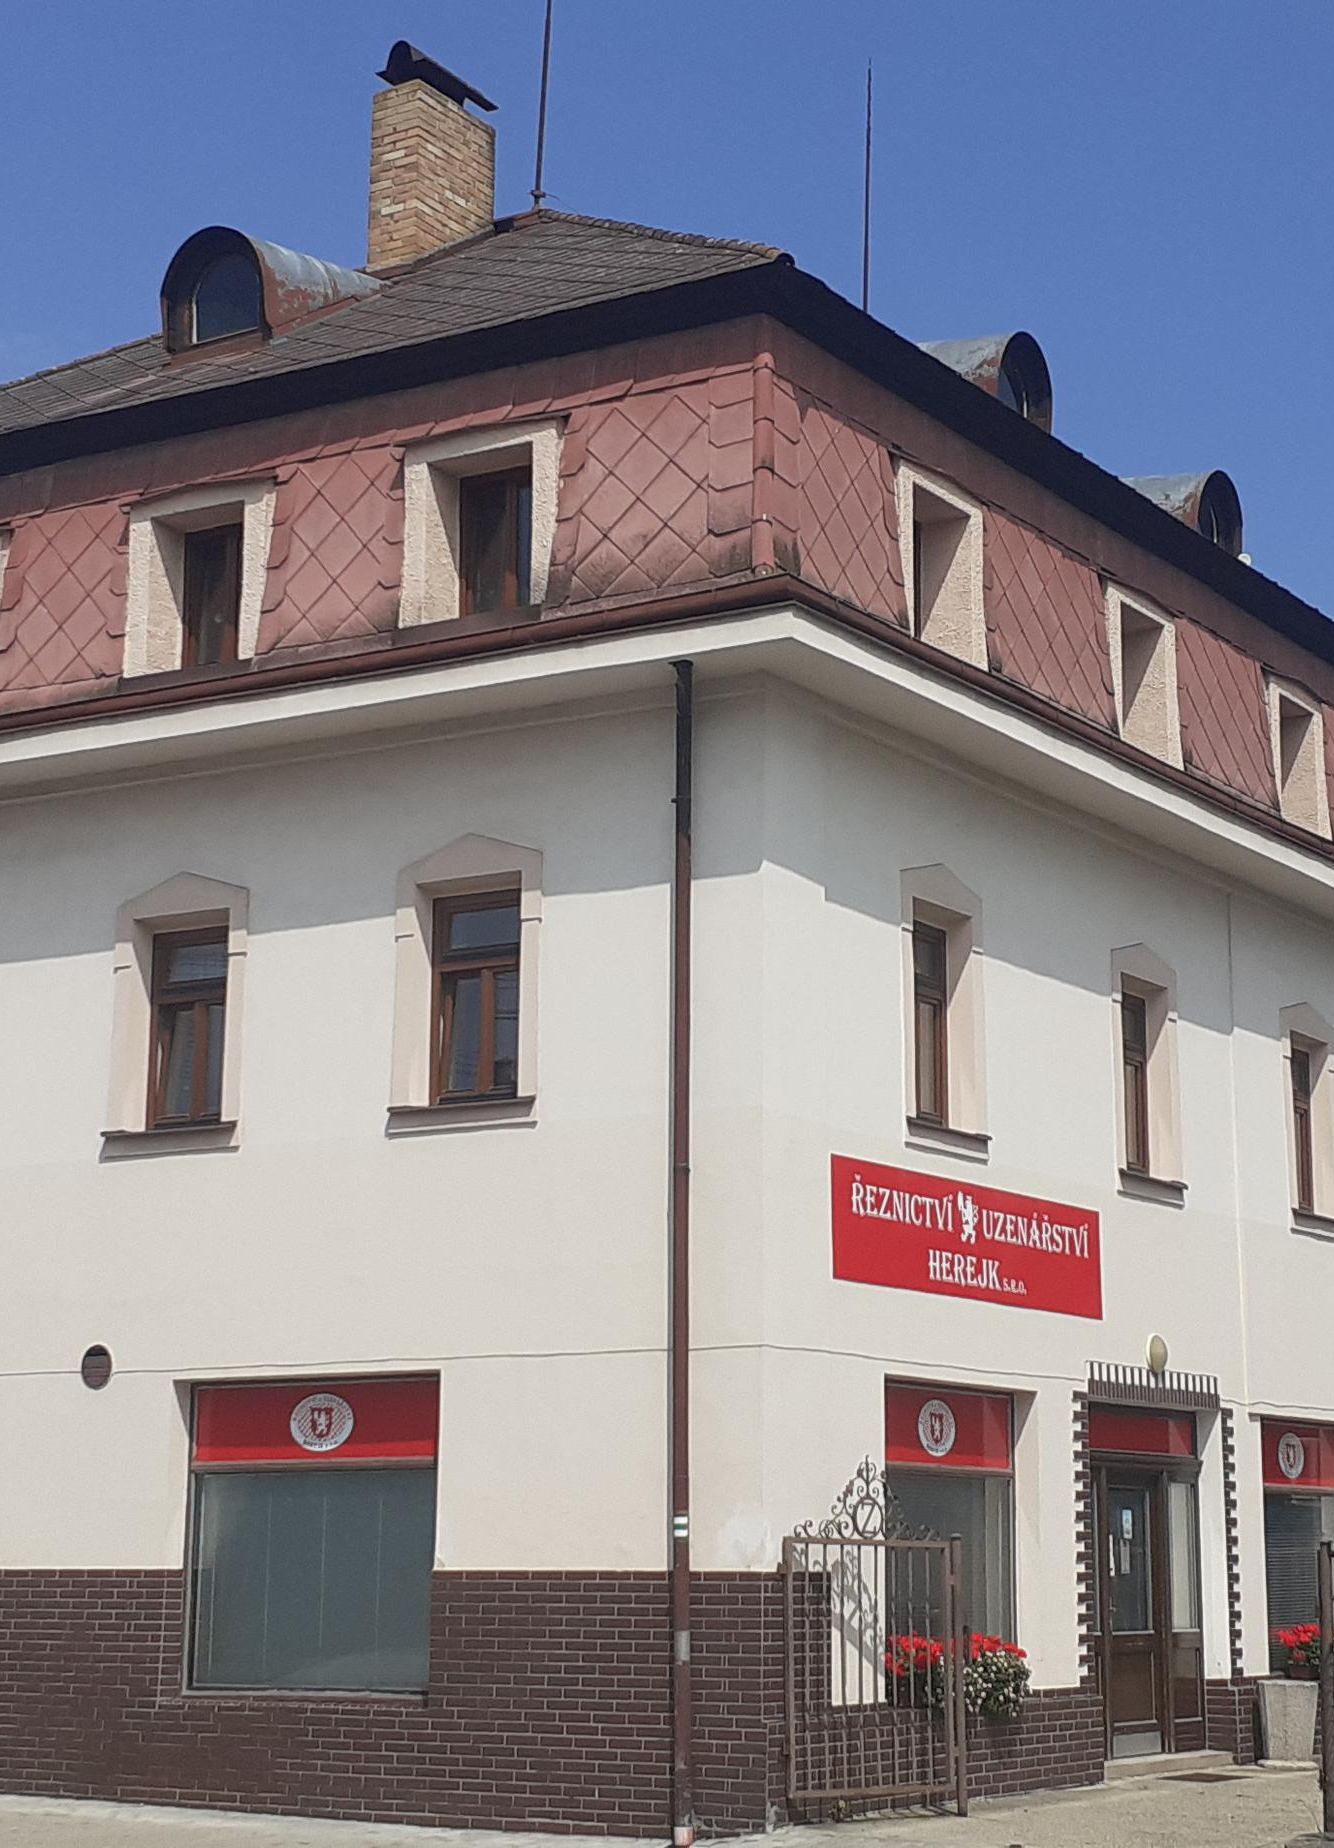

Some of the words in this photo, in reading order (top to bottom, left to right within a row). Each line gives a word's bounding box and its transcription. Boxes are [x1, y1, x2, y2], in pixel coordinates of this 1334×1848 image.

[851, 1174, 953, 1232] ŘEZNICTVÍ
[982, 1210, 1089, 1259] UZENÁŘSTVÍ
[928, 1249, 1002, 1291] HEREJK
